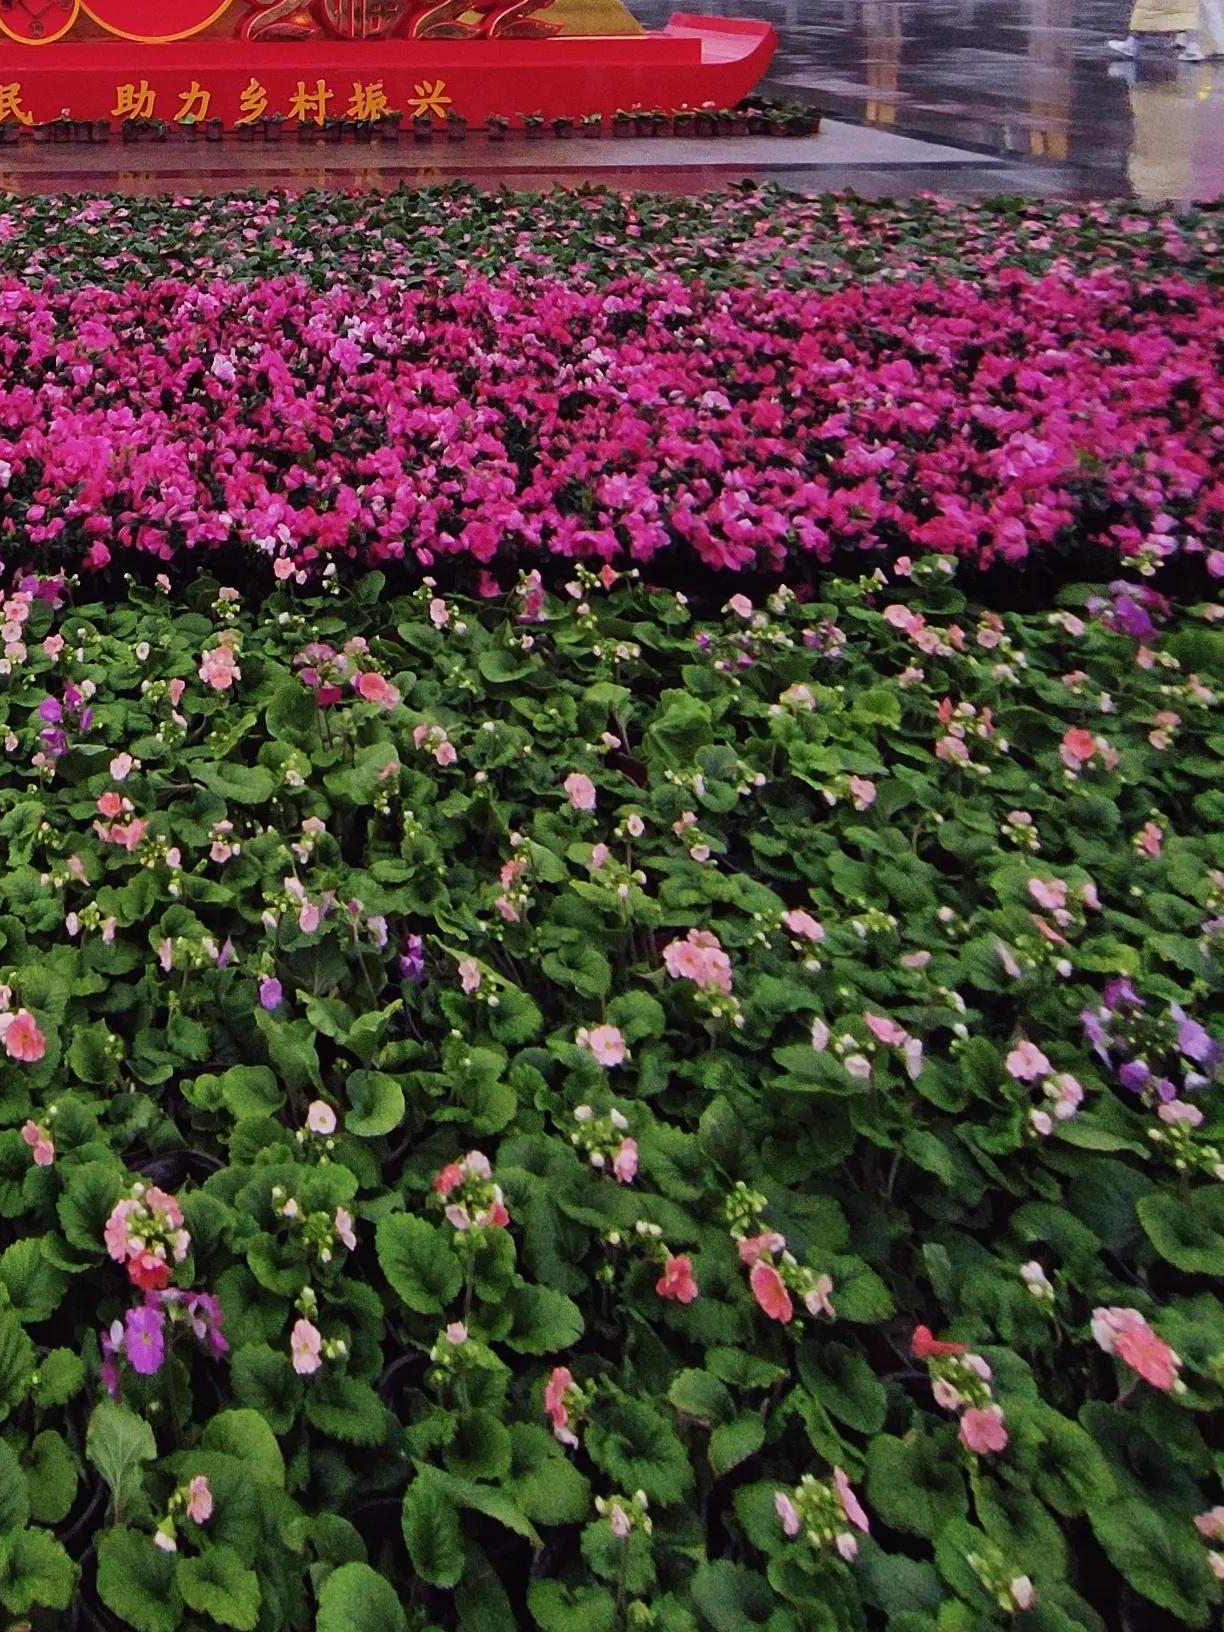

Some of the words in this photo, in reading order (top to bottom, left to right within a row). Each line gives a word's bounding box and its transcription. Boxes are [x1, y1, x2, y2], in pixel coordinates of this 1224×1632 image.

[110, 77, 453, 126] 助力乡村振兴
